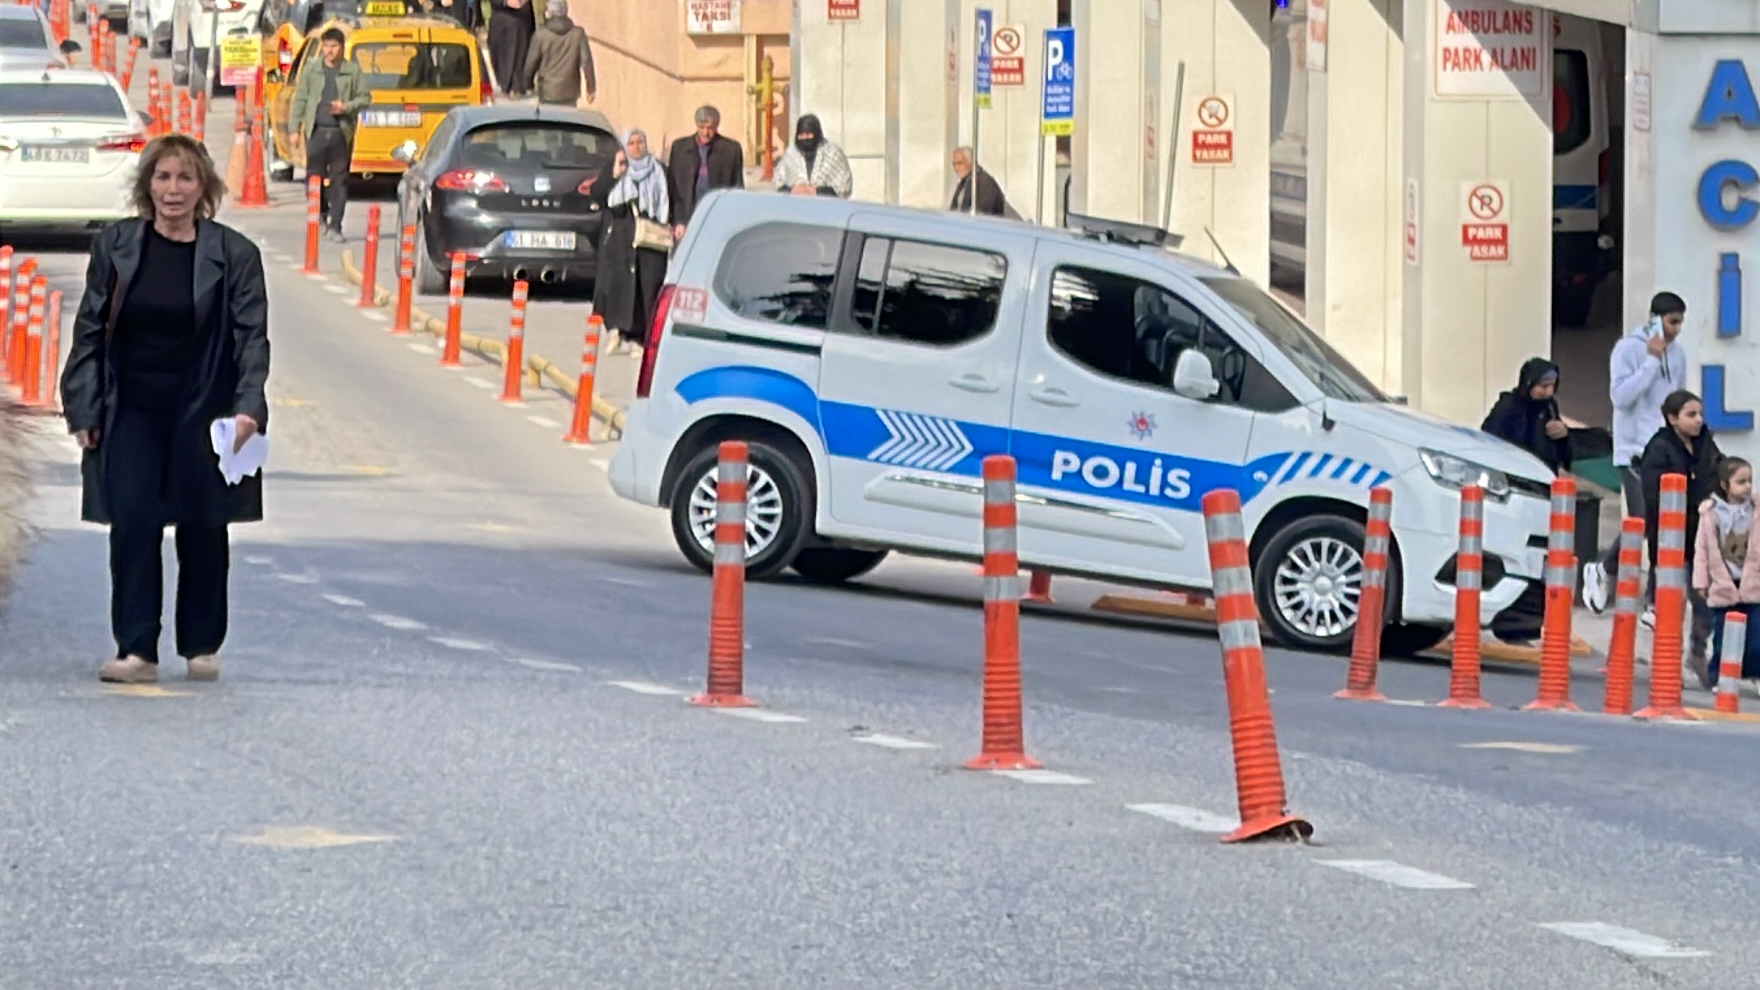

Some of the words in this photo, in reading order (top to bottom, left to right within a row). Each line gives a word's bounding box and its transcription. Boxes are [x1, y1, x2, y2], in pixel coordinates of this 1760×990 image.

[1446, 10, 1533, 34] AMBULANS
[1443, 47, 1484, 72] PARK
[1491, 47, 1537, 72] ALANI
[1198, 133, 1227, 145] PARK
[1195, 149, 1229, 160] YASAK
[1468, 227, 1503, 240] PARK
[680, 290, 704, 309] 112
[1051, 450, 1191, 499] POLİS
